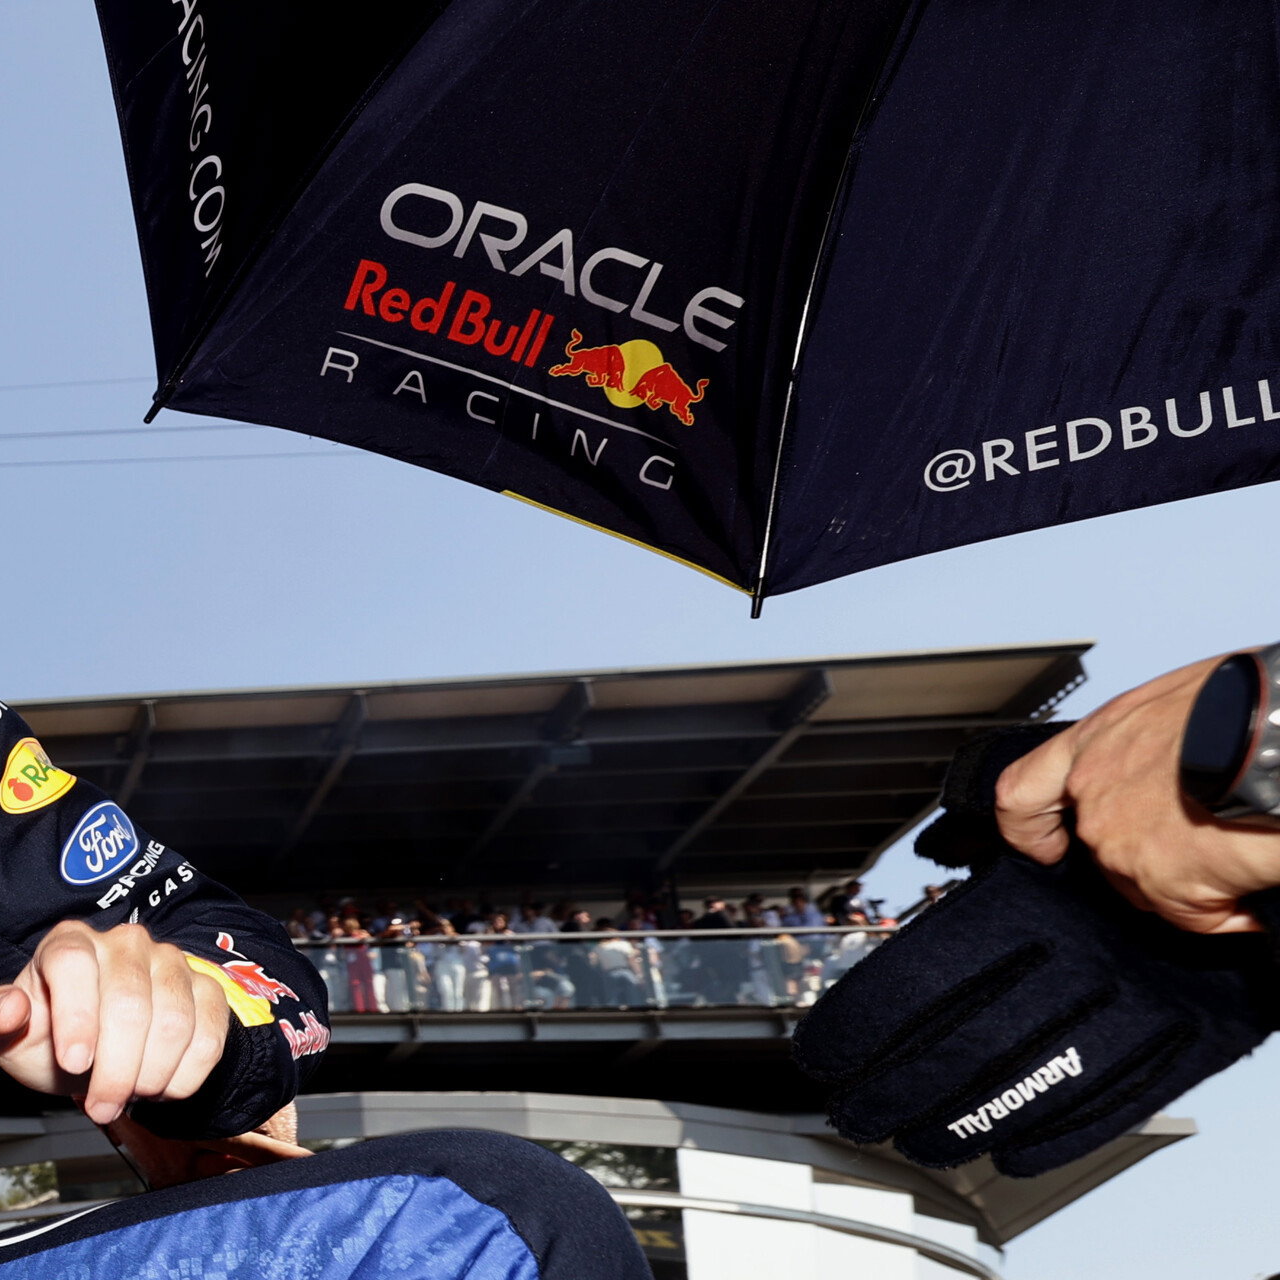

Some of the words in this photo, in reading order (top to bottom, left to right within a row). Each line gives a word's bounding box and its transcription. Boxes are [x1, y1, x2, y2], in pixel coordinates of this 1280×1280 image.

[380, 182, 746, 353] ORACLE
[320, 346, 676, 490] RACING
[77, 812, 132, 874] Ford
[96, 839, 166, 910] RACING
